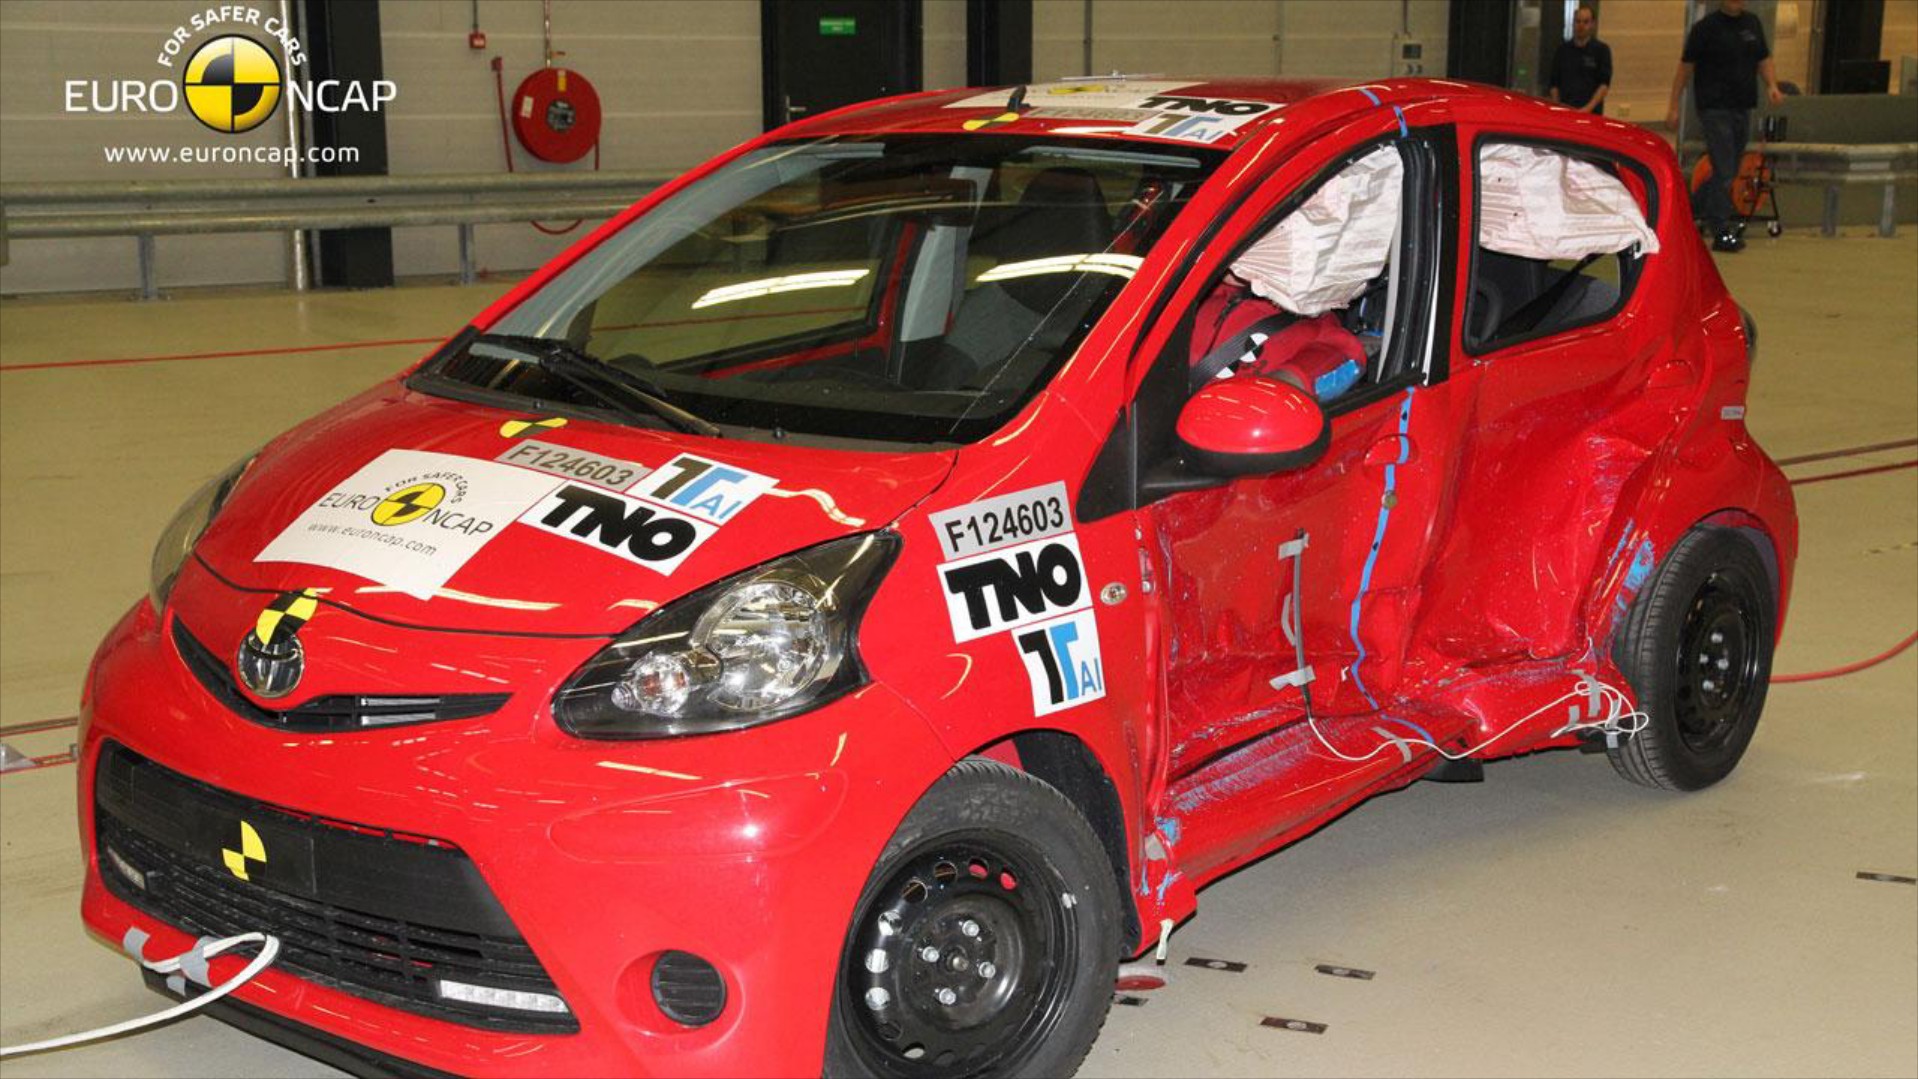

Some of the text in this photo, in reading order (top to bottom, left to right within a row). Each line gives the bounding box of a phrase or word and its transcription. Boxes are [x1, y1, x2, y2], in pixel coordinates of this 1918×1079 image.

[1138, 96, 1270, 115] TNO
[507, 444, 634, 486] F124603
[318, 492, 494, 536] EURO NCAP
[540, 484, 696, 561] TNO
[945, 496, 1064, 552] F124603
[308, 523, 437, 556] www.euroncap.com
[944, 543, 1082, 630] TNO
